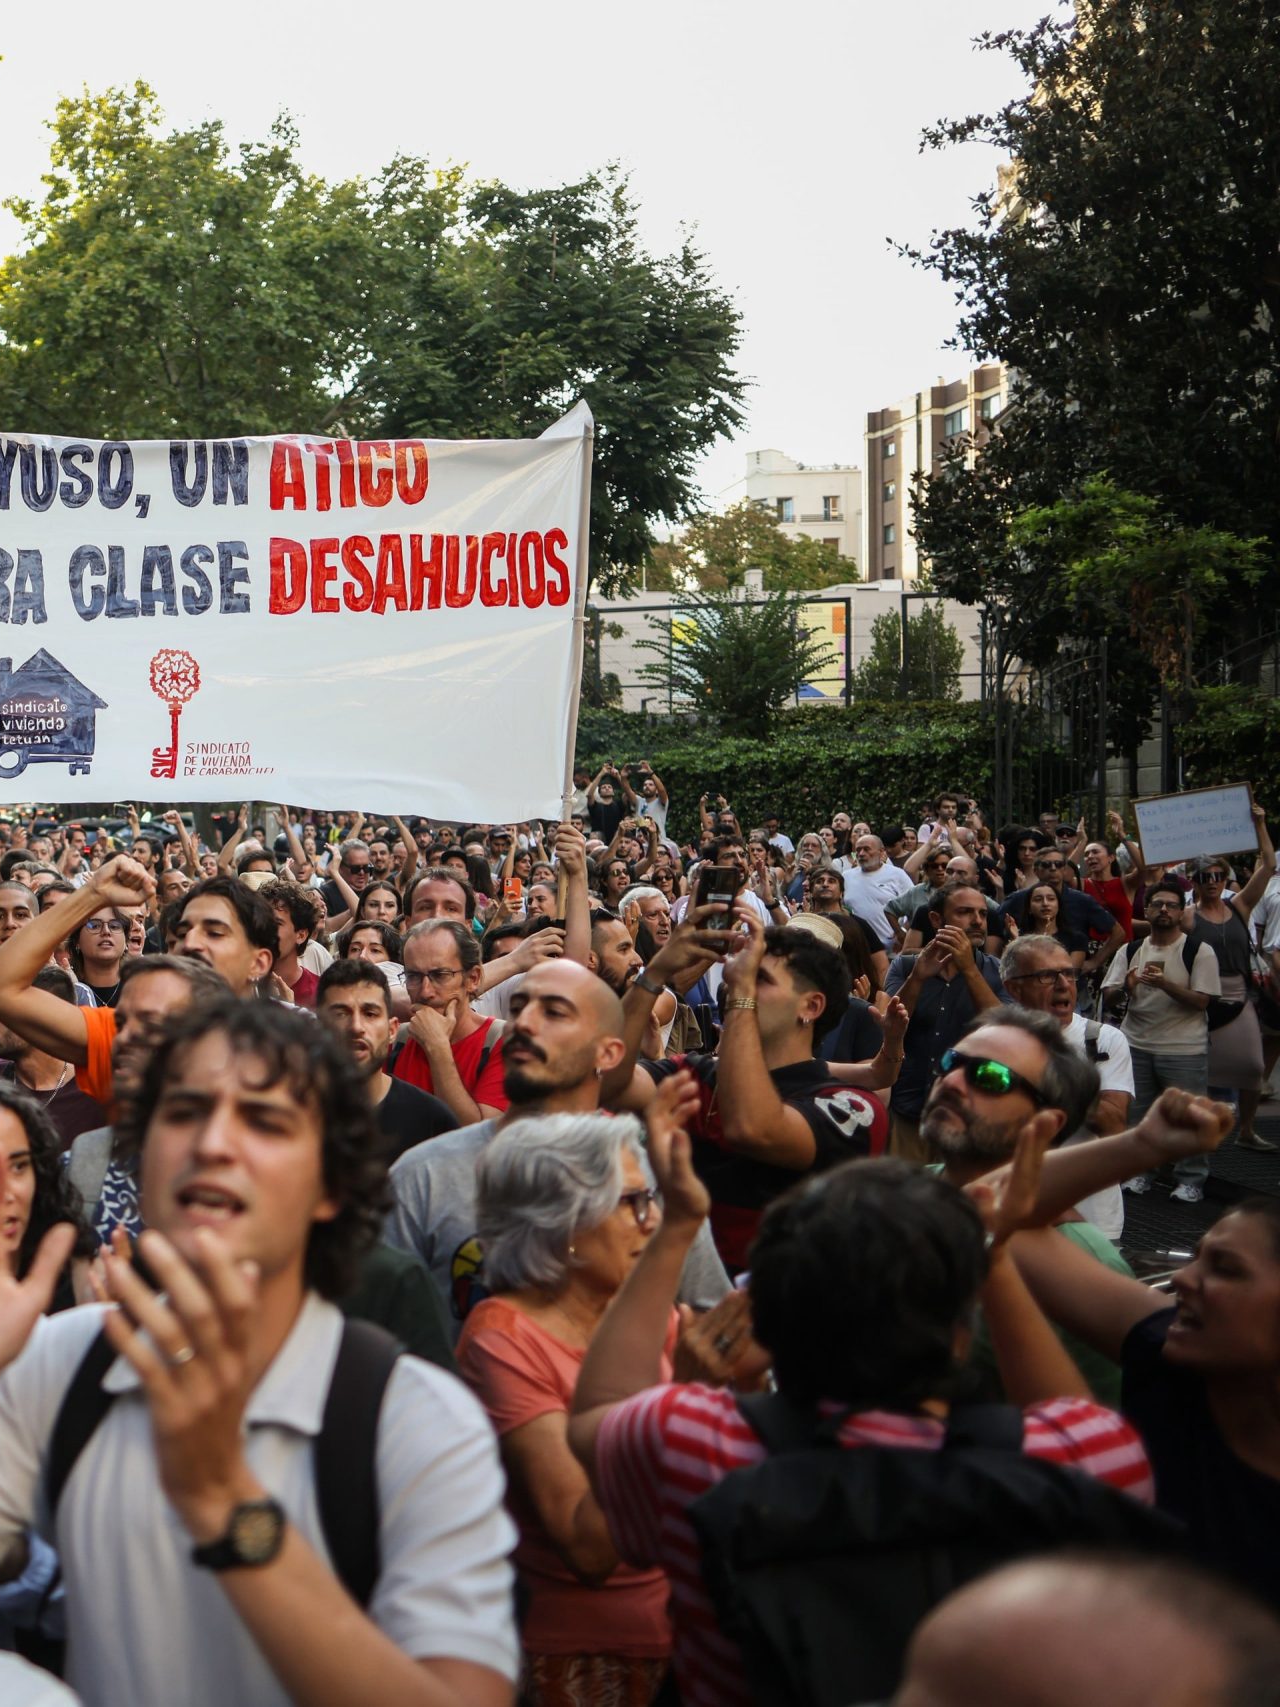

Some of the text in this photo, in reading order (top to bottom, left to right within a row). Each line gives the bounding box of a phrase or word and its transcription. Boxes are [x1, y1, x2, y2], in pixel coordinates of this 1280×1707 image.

[169, 440, 249, 508] UN
[68, 540, 251, 622] CLASE
[268, 527, 572, 617] DESAHUCIOS
[2, 697, 68, 715] sindicato
[2, 715, 65, 731] vivienda
[186, 742, 251, 755] SINDICATO
[185, 755, 252, 768] DE VIVIENDA
[184, 767, 197, 777] DE
